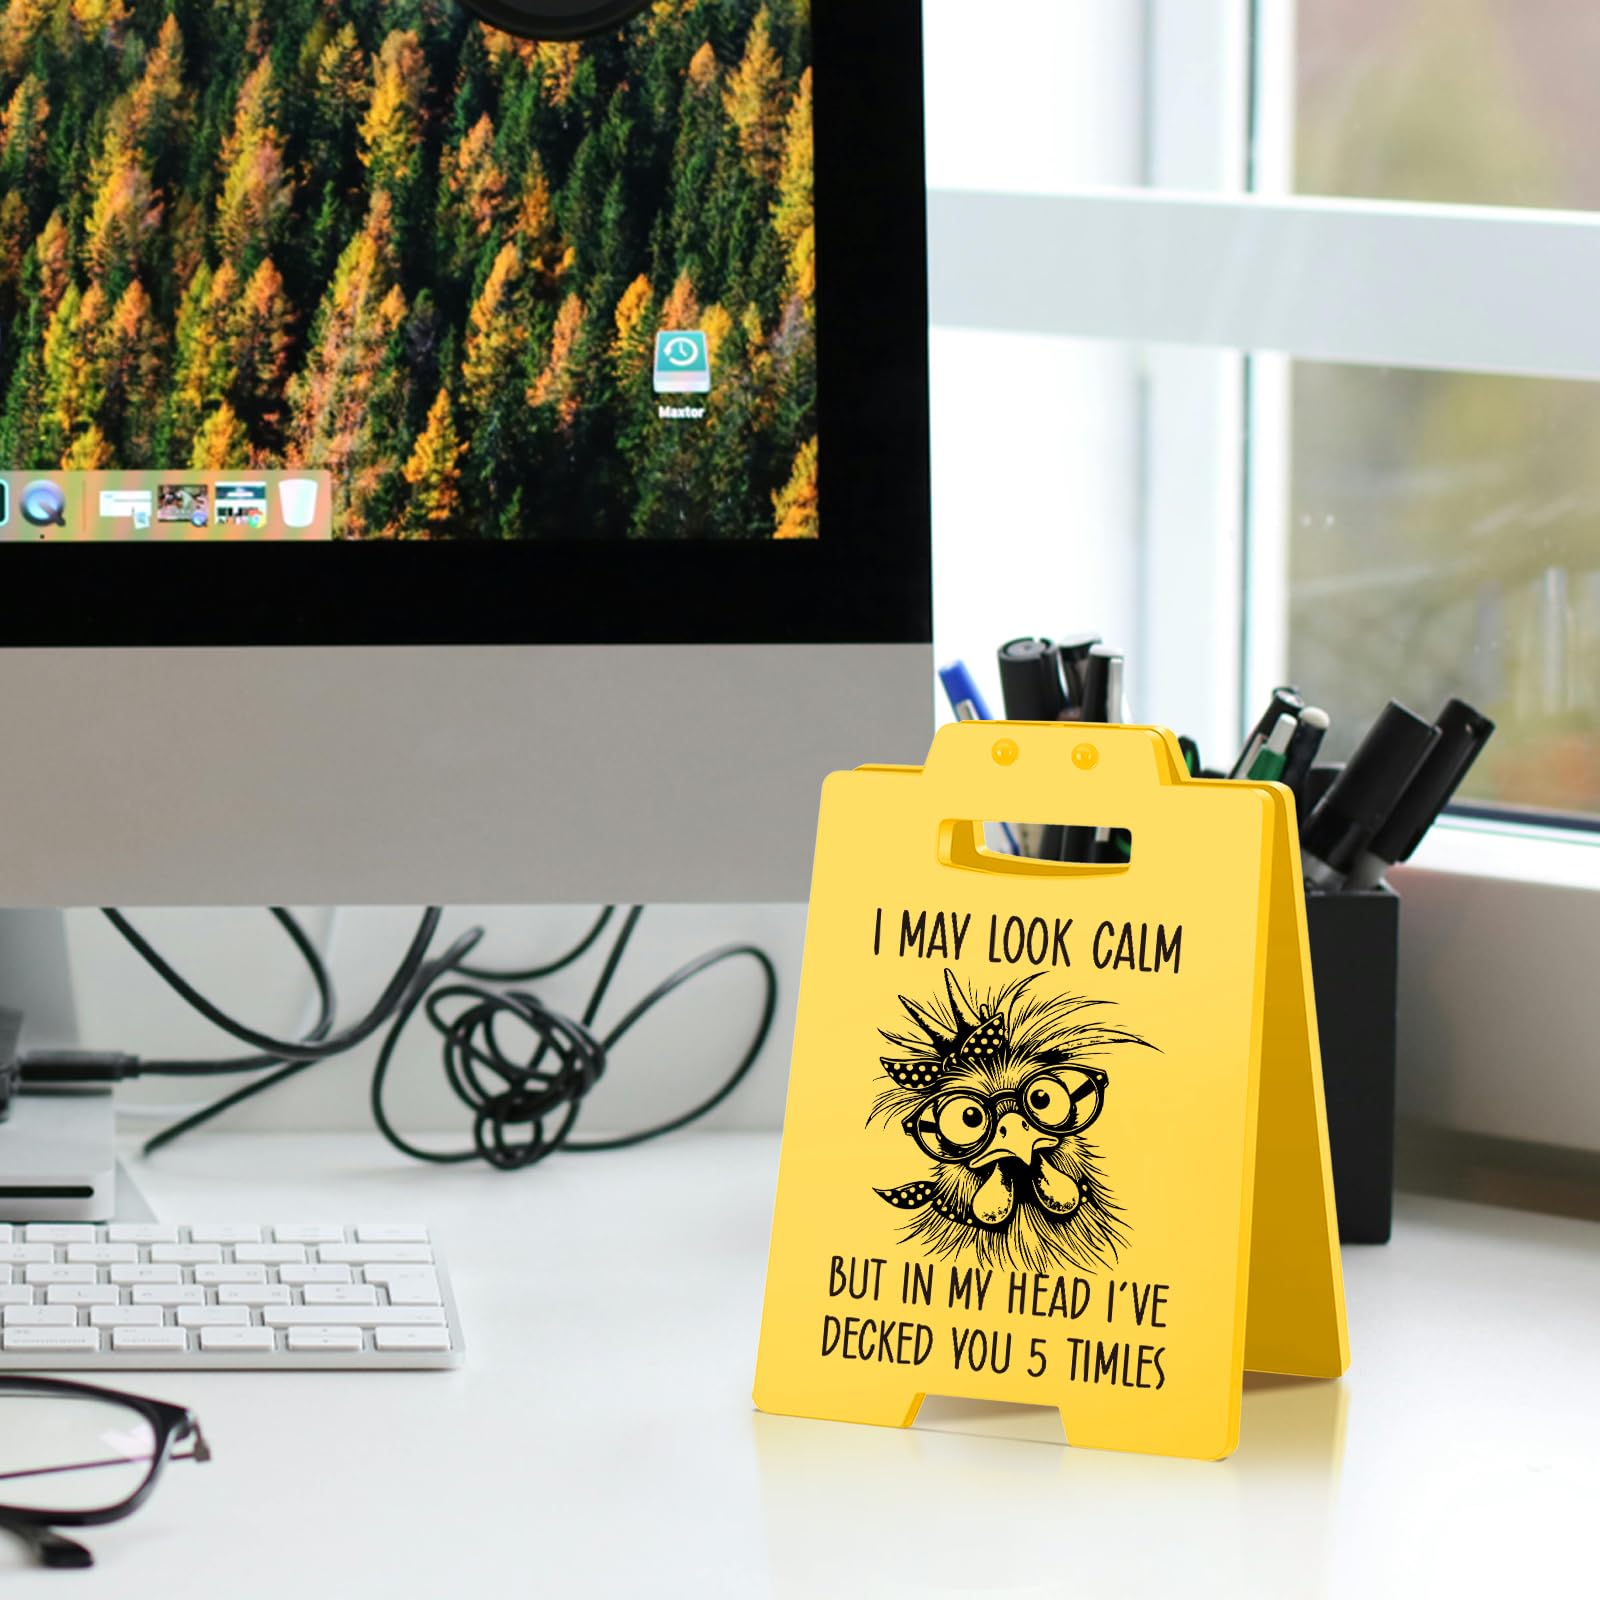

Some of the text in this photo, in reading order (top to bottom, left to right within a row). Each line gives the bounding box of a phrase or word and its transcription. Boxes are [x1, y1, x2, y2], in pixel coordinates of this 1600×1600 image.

[658, 405, 705, 418] Maxtor
[873, 907, 1183, 974] I MAY LOOK CALM
[829, 1255, 1170, 1328] BUT IN MY HEAD I'VE
[821, 1314, 1166, 1391] DECKED YOU 5 TIMLES
